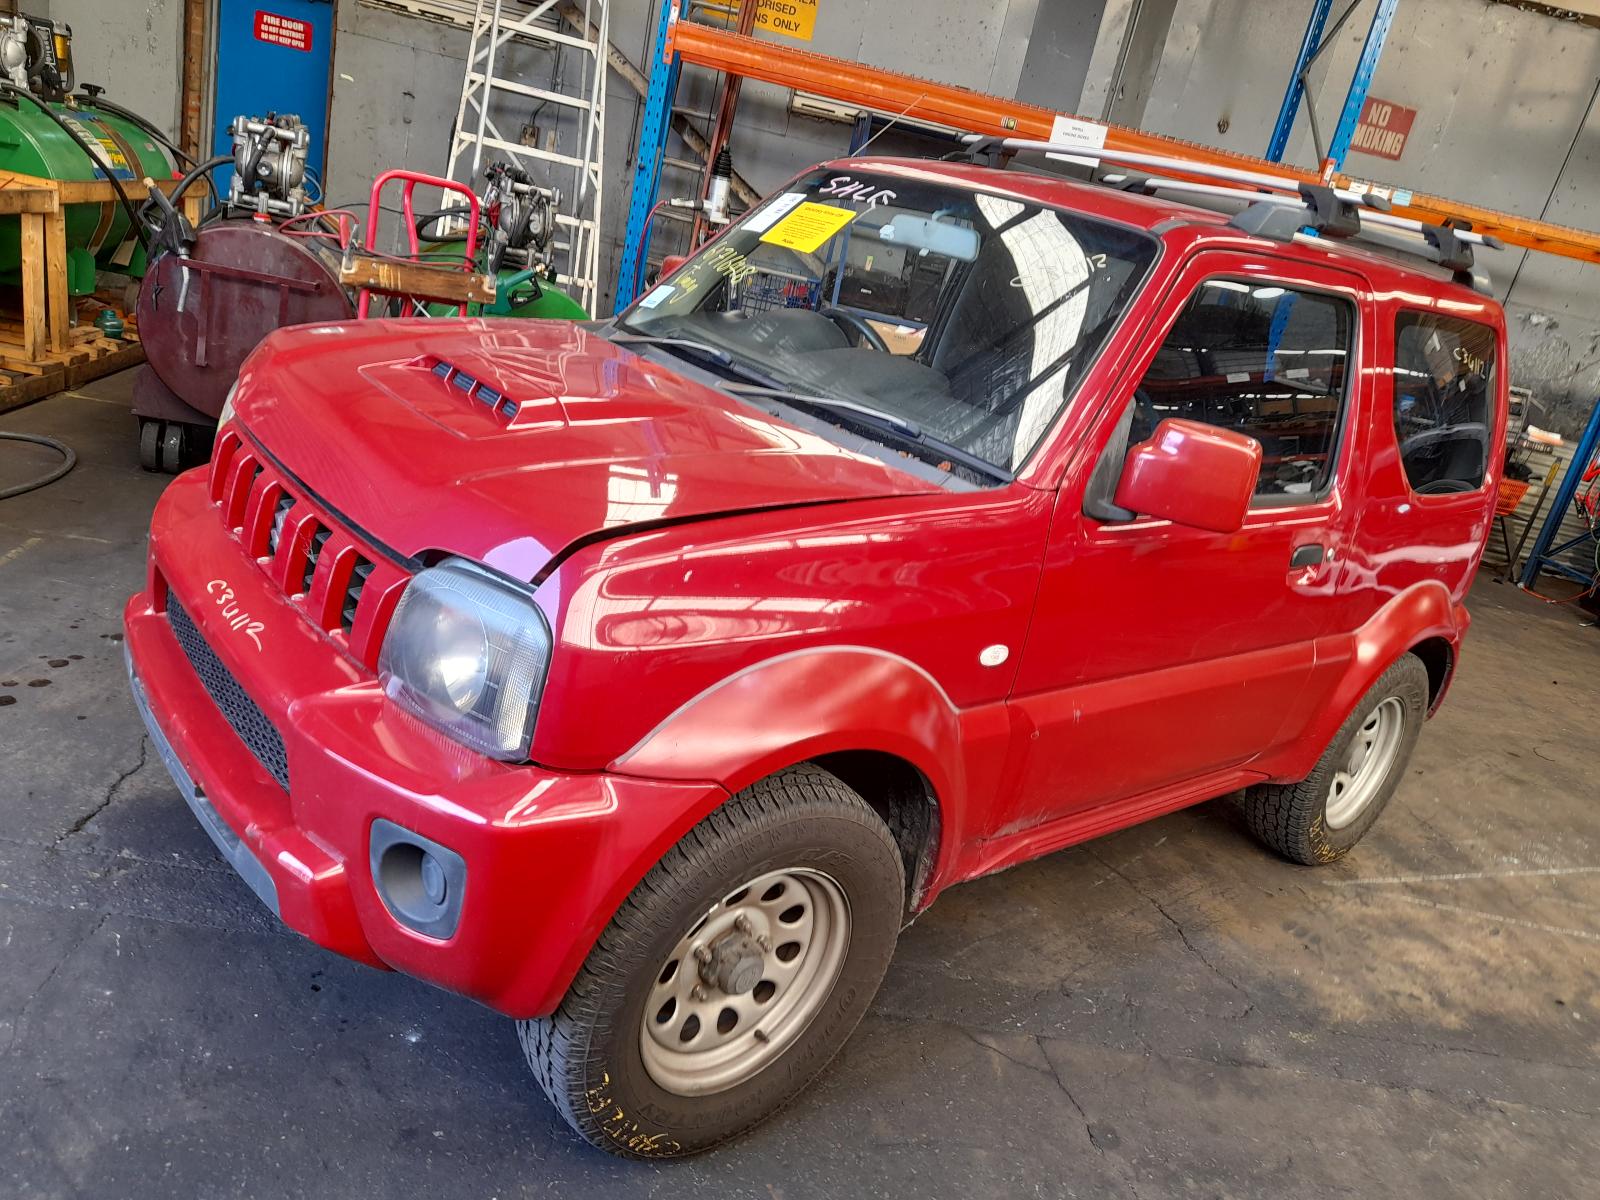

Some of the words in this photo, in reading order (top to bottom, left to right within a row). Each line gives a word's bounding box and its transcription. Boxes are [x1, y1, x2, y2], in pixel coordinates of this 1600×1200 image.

[757, 0, 797, 15] ORISED
[263, 14, 280, 26] FIRE
[281, 19, 304, 32] DOOR
[773, 17, 801, 32] ONLY
[269, 26, 279, 34] NOT
[279, 28, 305, 40] OBSTRUCT
[269, 34, 279, 42] NOT
[279, 36, 291, 45] KEEP
[292, 40, 305, 48] OPEN
[1367, 102, 1393, 128] NO
[1350, 123, 1405, 156] MOKING
[1452, 347, 1486, 380] C34112
